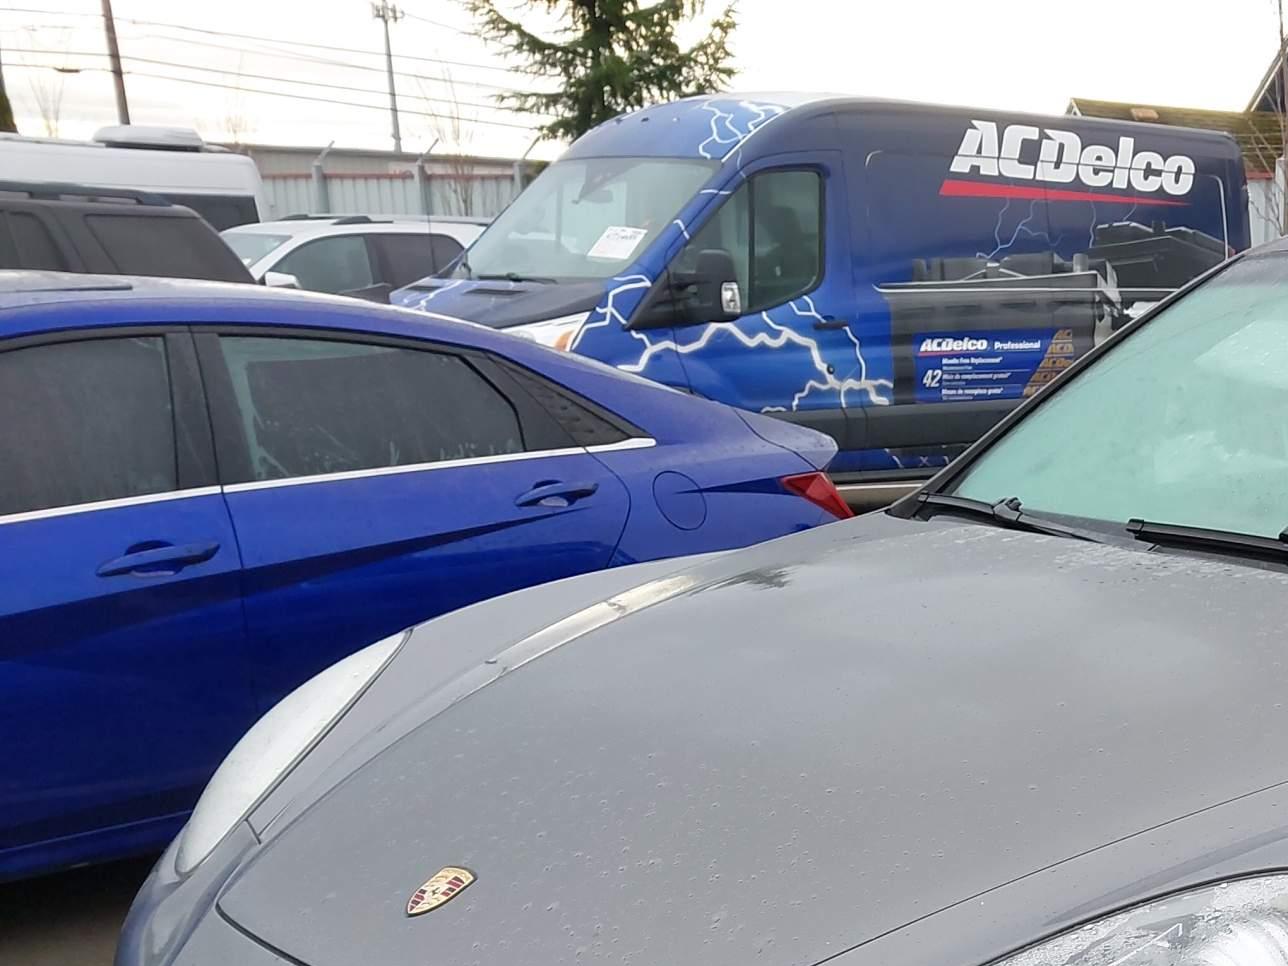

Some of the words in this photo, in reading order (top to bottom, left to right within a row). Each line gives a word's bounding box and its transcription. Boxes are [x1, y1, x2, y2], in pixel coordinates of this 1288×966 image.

[950, 120, 1196, 196] ACDelco
[919, 337, 989, 352] ACDelco
[994, 340, 1041, 350] Professional
[923, 369, 942, 387] 42
